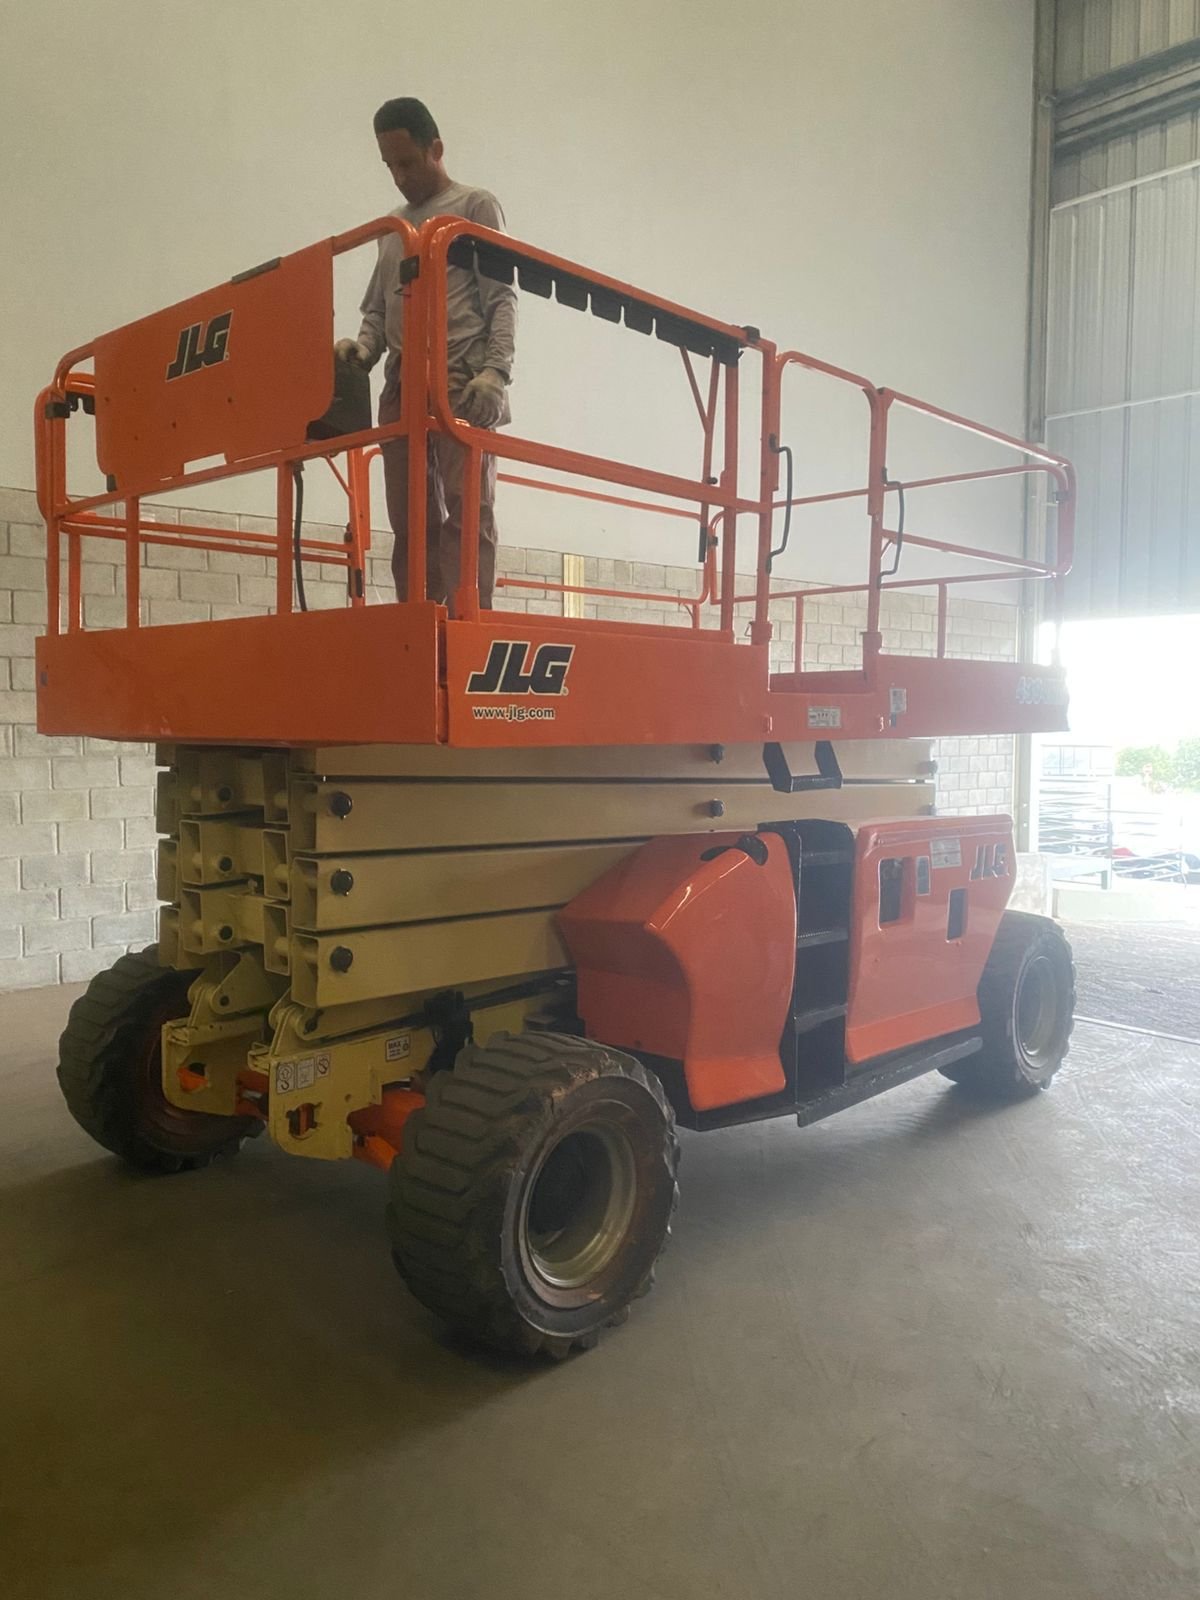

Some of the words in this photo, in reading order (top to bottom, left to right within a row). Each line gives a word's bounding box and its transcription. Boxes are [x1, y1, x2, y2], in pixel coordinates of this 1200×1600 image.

[165, 309, 234, 383] JLG
[465, 639, 576, 696] JLG
[472, 704, 555, 722] www.jlg.com
